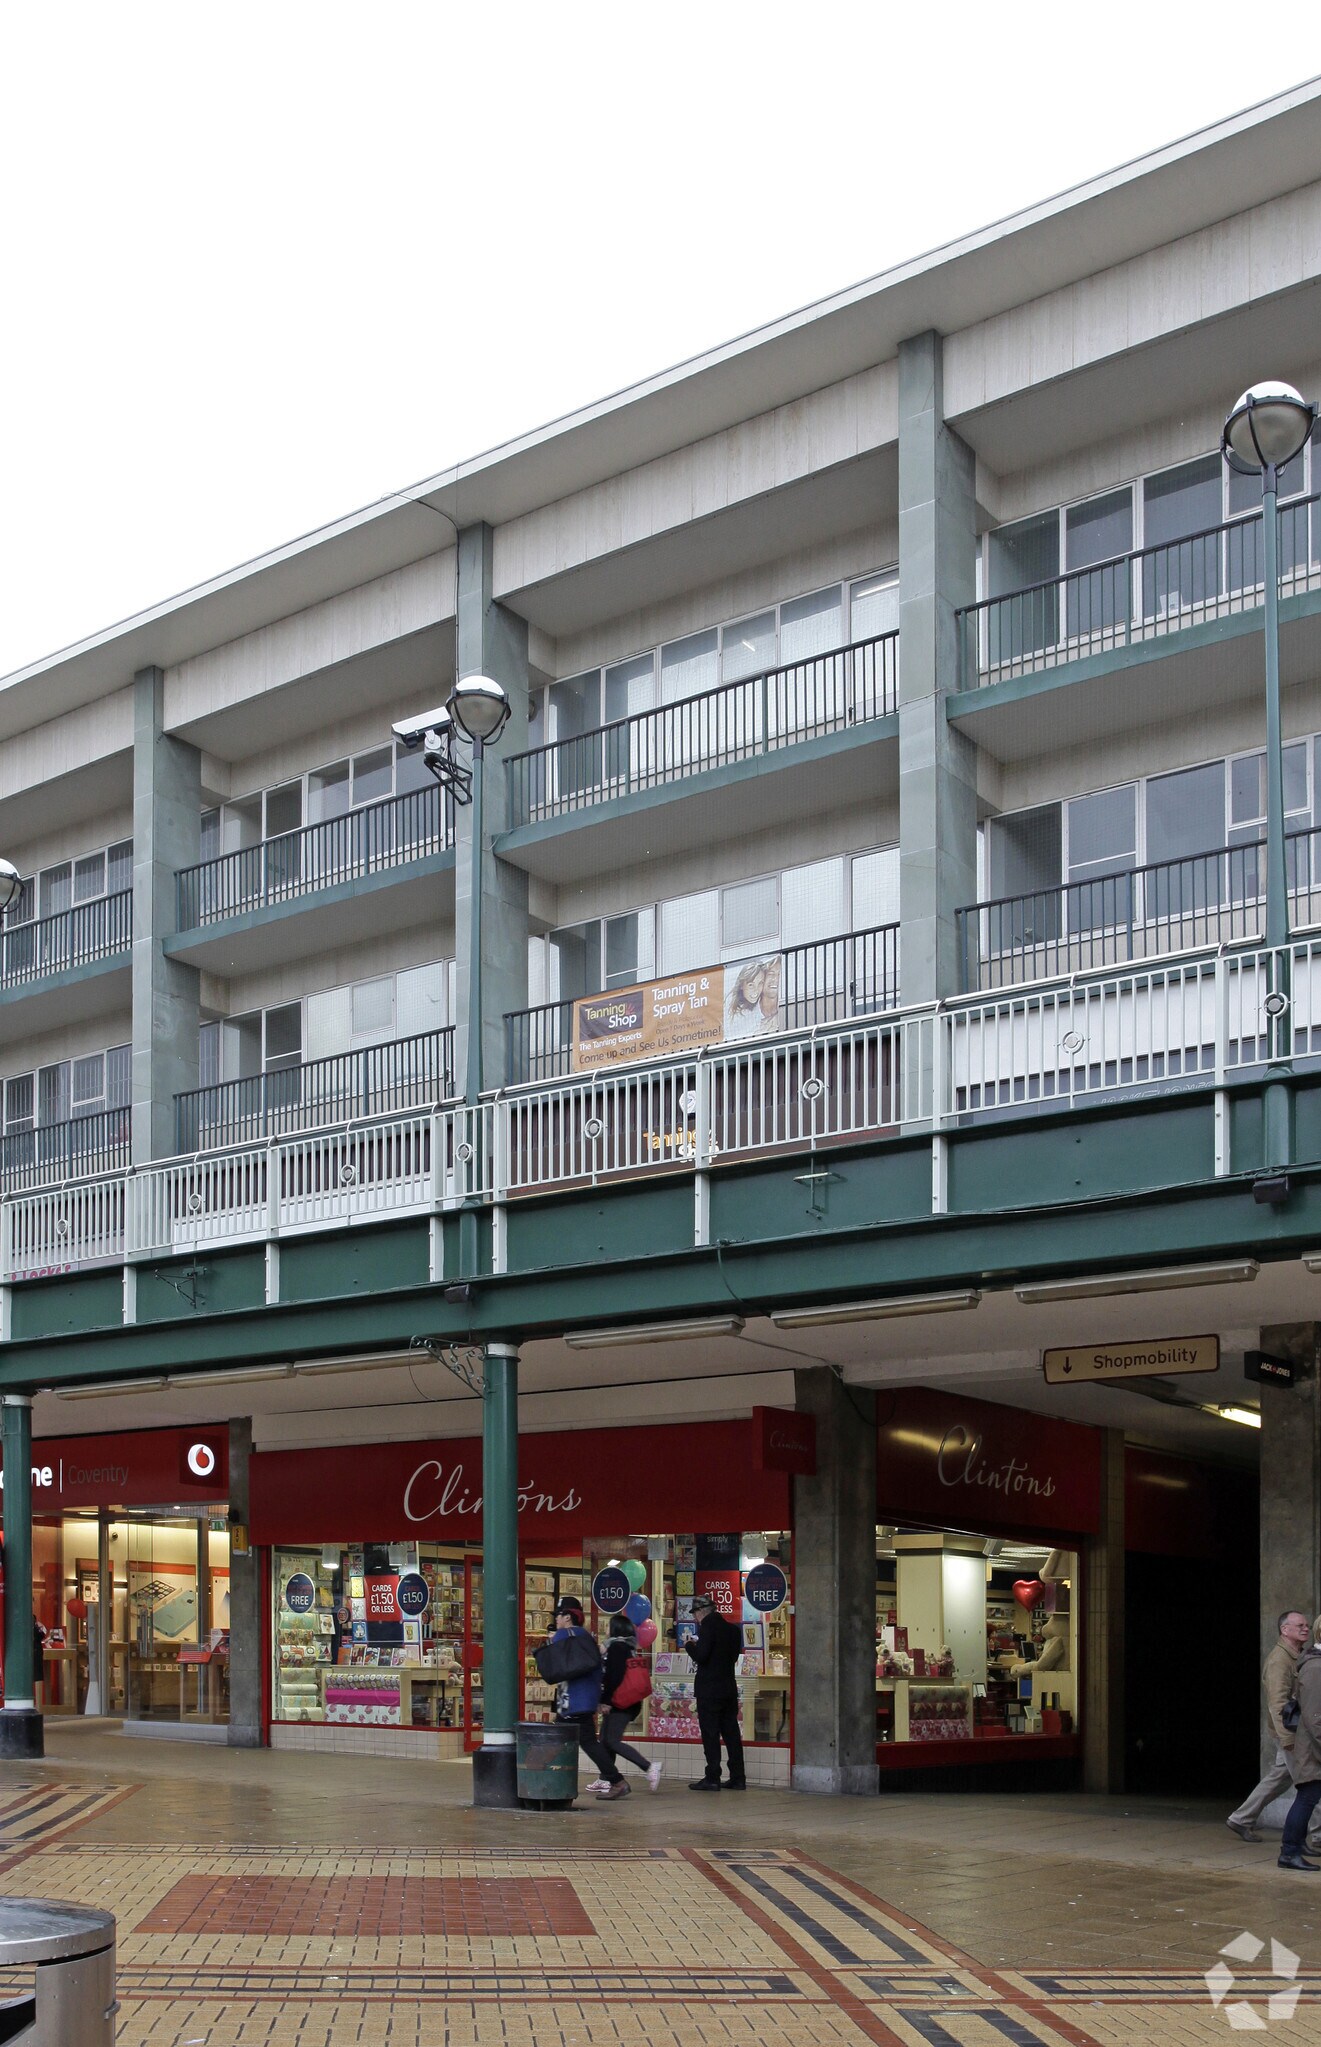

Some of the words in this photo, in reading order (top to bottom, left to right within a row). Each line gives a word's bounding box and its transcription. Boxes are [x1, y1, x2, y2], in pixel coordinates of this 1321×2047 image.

[652, 982, 697, 1001] Tanning
[700, 977, 709, 990] &
[585, 1003, 626, 1020] Tanning
[653, 1001, 685, 1019] Spray
[688, 996, 708, 1009] Tan
[608, 1014, 637, 1028] Shop
[579, 1043, 591, 1051] The
[593, 1037, 617, 1049] Tanning
[618, 1031, 642, 1043] Experts
[579, 1053, 605, 1065] Come
[606, 1049, 617, 1060] up
[620, 1042, 637, 1056] and
[639, 1041, 655, 1051] See
[658, 1037, 669, 1048] Us
[671, 1025, 721, 1045] Sometime!
[1093, 1349, 1198, 1370] Shopmobility
[938, 1425, 1056, 1497] Clintons
[68, 1464, 129, 1486] Coventry
[371, 1584, 392, 1592] CARDS
[705, 1581, 731, 1590] CARDS
[290, 1595, 309, 1606] FREE
[371, 1592, 394, 1605] £1.50
[402, 1591, 423, 1604] £1.50
[599, 1587, 624, 1600] £1.50
[753, 1590, 779, 1602] FREE
[371, 1605, 381, 1613] OR
[381, 1605, 395, 1613] LESS
